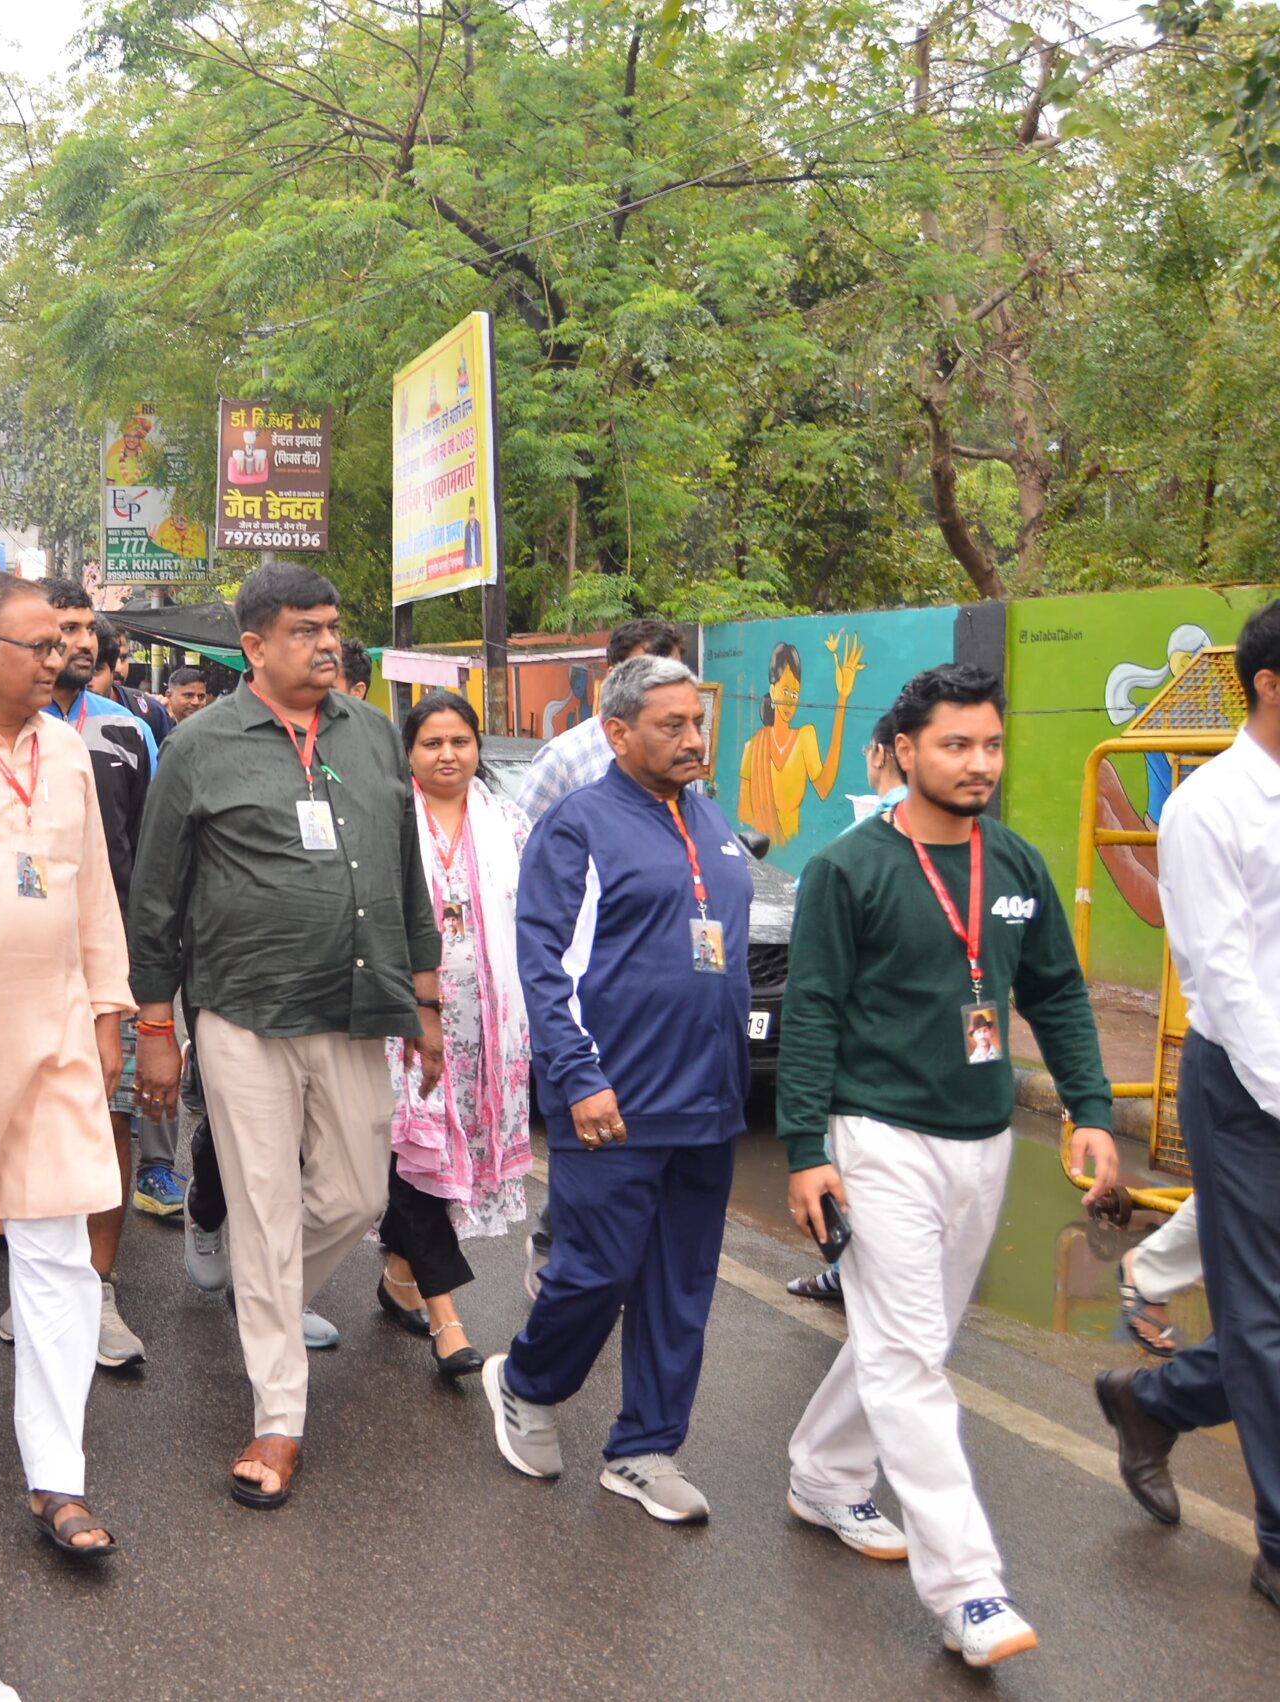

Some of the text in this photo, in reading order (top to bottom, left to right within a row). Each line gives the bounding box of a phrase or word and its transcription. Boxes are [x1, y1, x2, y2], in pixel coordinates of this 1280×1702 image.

[230, 409, 248, 428] डॉ.
[271, 432, 294, 447] डेन्टल
[223, 488, 325, 520] जैन डेन्टल
[121, 537, 148, 553] 777
[224, 531, 321, 547] 7976300196
[107, 559, 128, 570] E.P.
[991, 895, 1034, 919] 404
